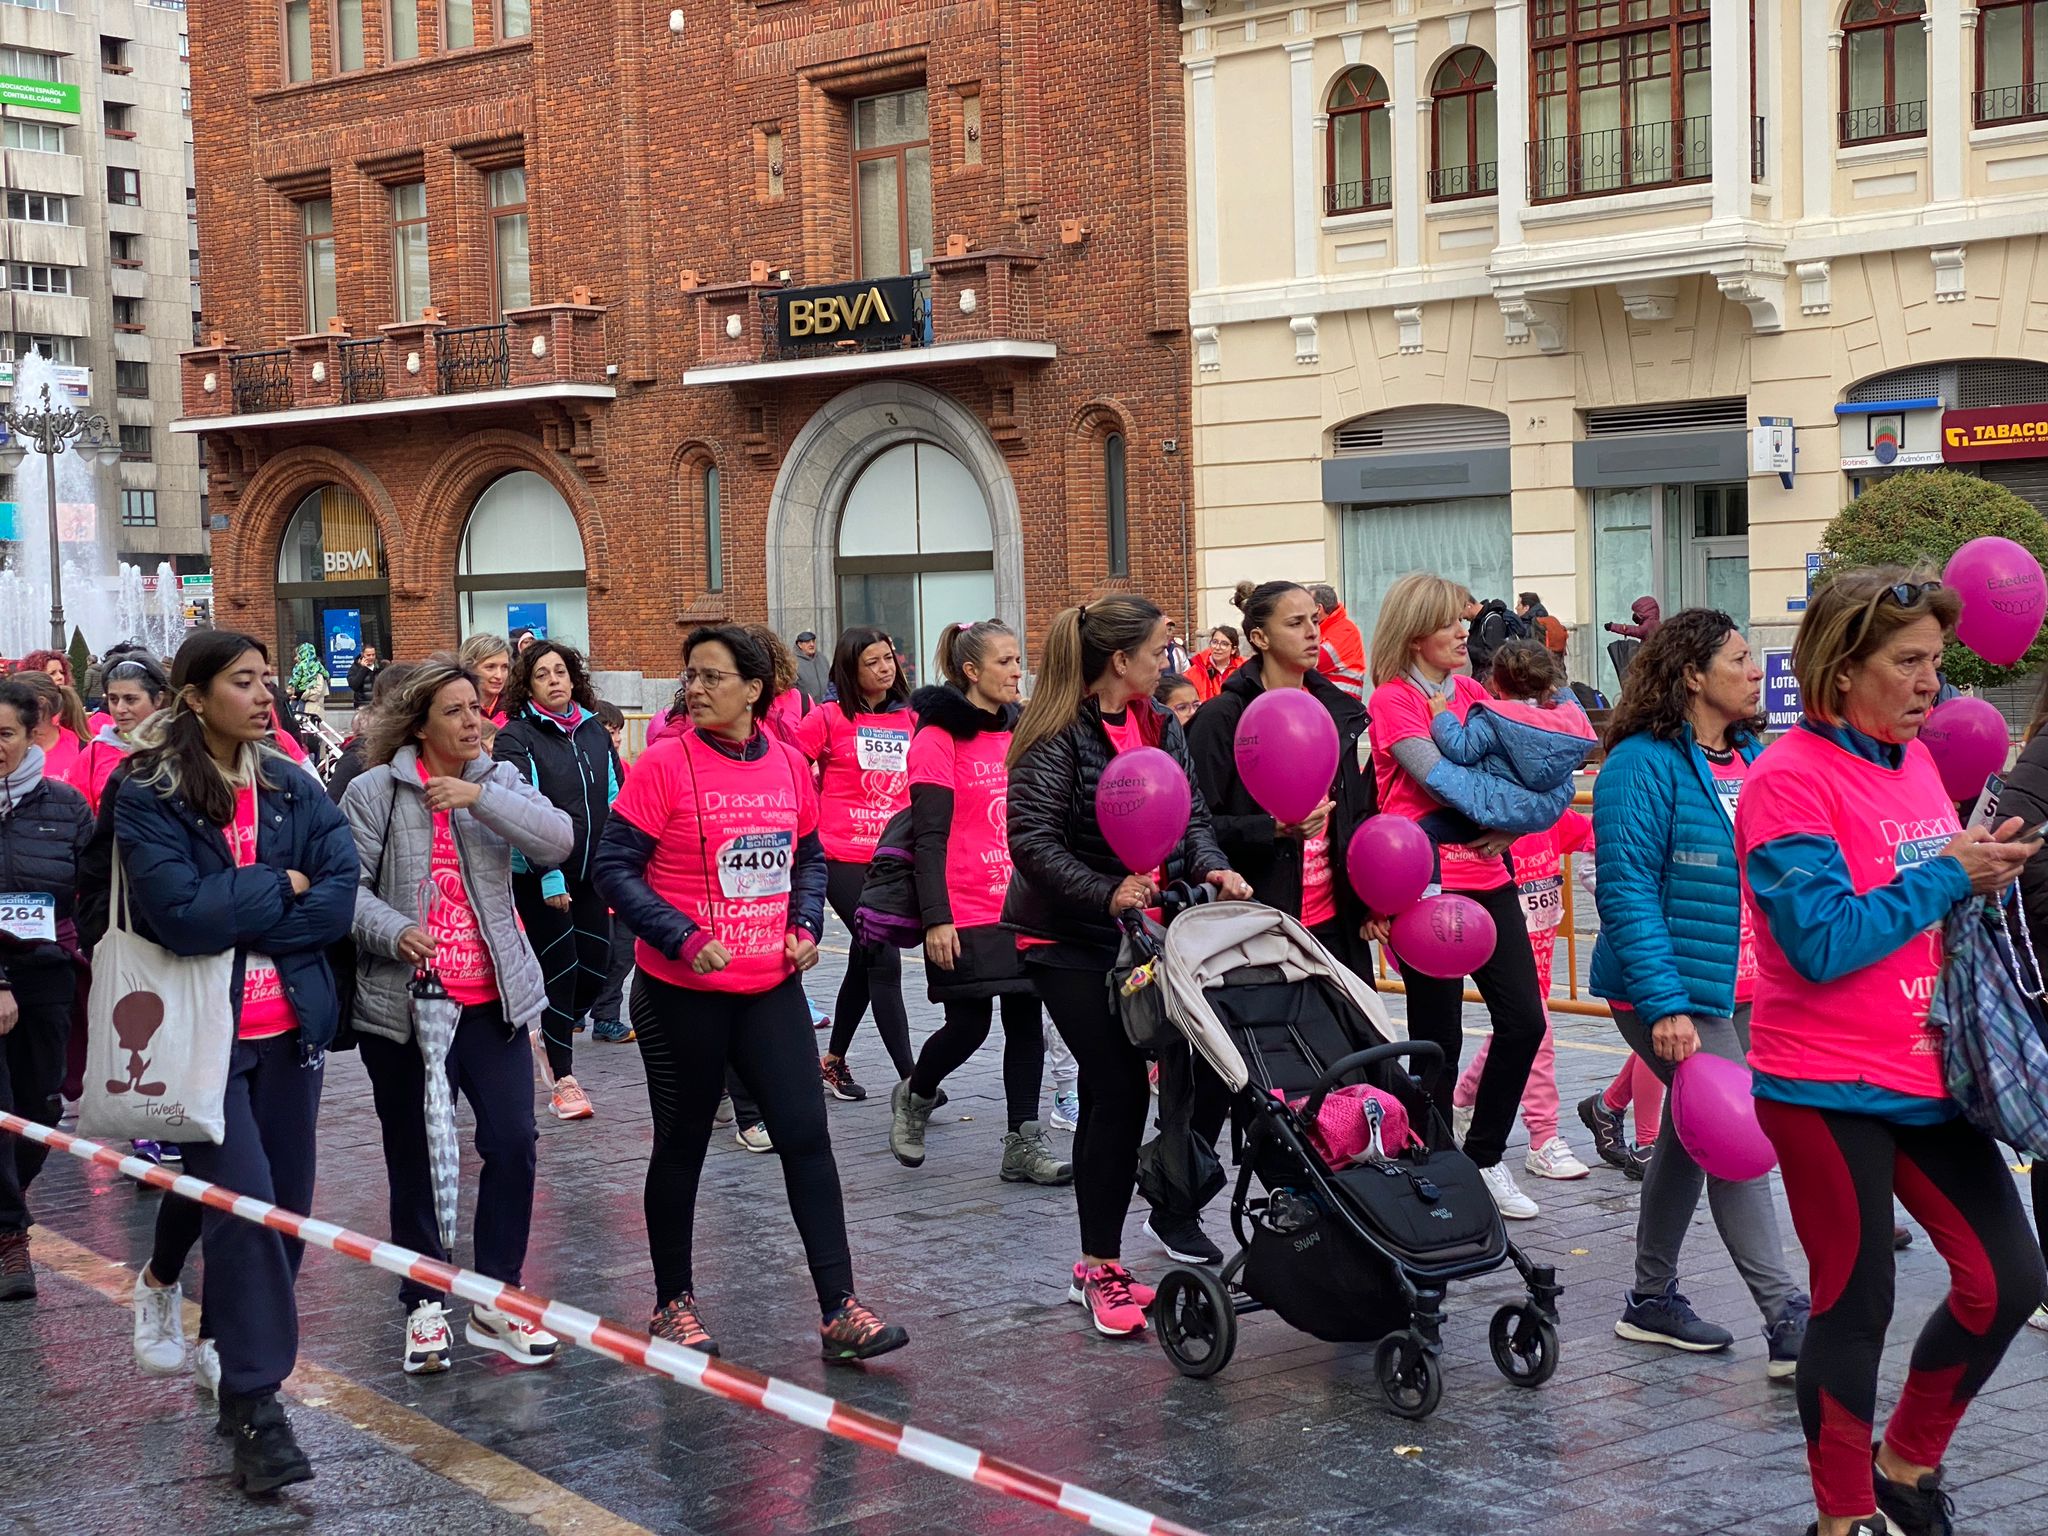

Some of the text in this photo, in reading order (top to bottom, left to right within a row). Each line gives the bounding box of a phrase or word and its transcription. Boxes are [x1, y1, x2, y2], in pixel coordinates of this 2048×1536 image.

[3, 91, 29, 100] CONTRA
[37, 95, 61, 105] CÁNCER
[35, 87, 67, 97] ESPAÑOLA
[789, 286, 891, 337] BBVA
[1842, 458, 1868, 470] Botines
[1900, 454, 1926, 464] Admón
[1935, 453, 1941, 461] 9
[324, 547, 372, 572] BBVA
[1784, 694, 1796, 706] DE
[865, 739, 904, 754] 5634
[705, 790, 788, 811] Drasanvi
[728, 849, 787, 870] 4400
[1, 907, 46, 921] 264
[435, 946, 488, 970] Mujer
